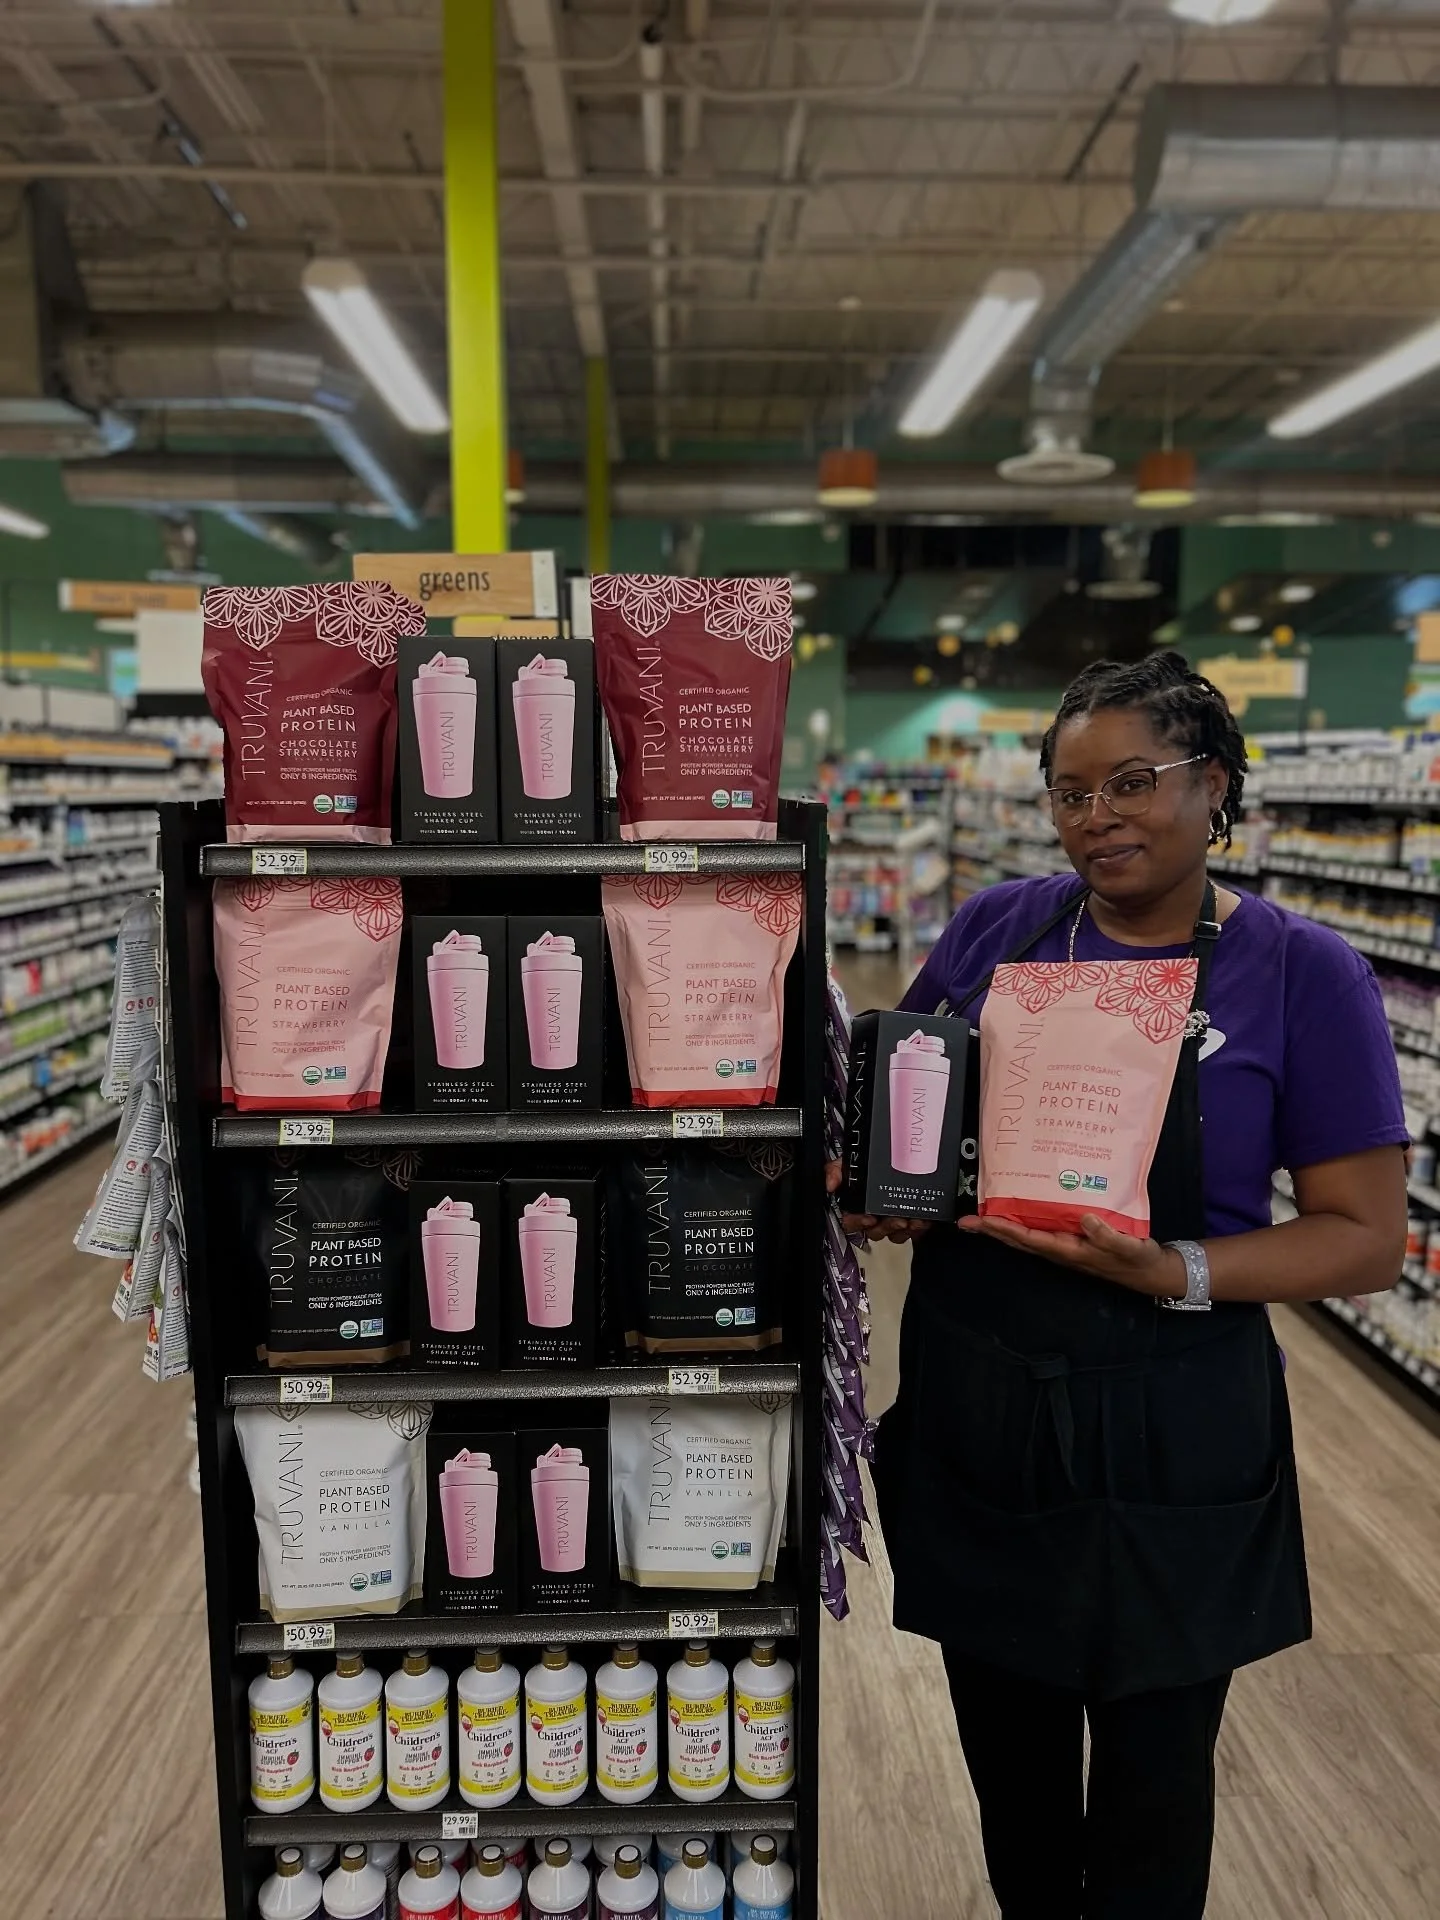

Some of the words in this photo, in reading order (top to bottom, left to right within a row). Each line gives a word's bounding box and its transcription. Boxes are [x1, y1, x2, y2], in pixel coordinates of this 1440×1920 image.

[419, 571, 490, 601] greens
[286, 693, 320, 702] CERTIFIED
[321, 688, 353, 696] ORGANIC
[679, 687, 714, 696] CERTIFIED
[715, 687, 749, 695] ORGANIC
[283, 706, 316, 718] PLANT
[320, 705, 354, 716] BASED
[637, 647, 666, 776] TRUVANI
[679, 703, 713, 714] PLANT
[716, 704, 752, 714] BASED
[241, 660, 274, 781] TRUVANI
[281, 719, 356, 732] PROTEIN
[679, 717, 752, 729] PROTEIN
[280, 740, 357, 749] CHOCOLATE
[440, 711, 456, 780] TRUVANI
[539, 713, 555, 780] TRUVANI
[680, 736, 753, 744] CHOCOLATE
[279, 749, 357, 758] STRAWBERRY
[680, 744, 753, 753] STRAWBERRY
[280, 772, 300, 780] ONLY
[308, 772, 357, 781] INGREDIENTS
[680, 768, 700, 776] ONLY
[701, 768, 706, 776] 8
[708, 768, 753, 776] INGREDIENTS
[255, 854, 297, 867] $52.99
[648, 852, 687, 864] $50.99
[277, 966, 313, 974] CERTIFIED
[314, 967, 350, 975] ORGANIC
[686, 962, 720, 970] CERTIFIED
[236, 921, 266, 1050] TRUVANI
[275, 983, 311, 993] PLANT
[314, 986, 349, 996] BASED
[647, 919, 671, 1047] TRUVANI
[686, 979, 719, 989] PLANT
[723, 978, 757, 989] BASED
[274, 999, 348, 1011] PROTEIN
[685, 992, 755, 1005] PROTEIN
[272, 1019, 345, 1029] STRAWBERRY
[452, 986, 468, 1051] TRUVANI
[547, 988, 561, 1052] TRUVANI
[684, 1014, 753, 1022] STRAWBERRY
[300, 1045, 346, 1053] INGREDIENTS
[686, 1039, 704, 1047] ONLY
[712, 1038, 755, 1046] INGREDIENTS
[1083, 1064, 1122, 1077] ORGANIC
[994, 1023, 1044, 1151] TRUVANI
[1043, 1081, 1078, 1091] PLANT
[1081, 1083, 1121, 1097] BASED
[1039, 1096, 1118, 1116] PROTEIN
[675, 1117, 714, 1129] $52.99
[848, 1051, 866, 1187] TRUVANI
[910, 1087, 927, 1154] TRUVANI
[283, 1124, 323, 1136] $52.99
[1034, 1118, 1116, 1134] STRAWBERRY
[1031, 1145, 1050, 1153] ONLY
[1058, 1147, 1111, 1160] INGREDIENTS
[879, 1185, 920, 1193] STAINLESS
[312, 1222, 347, 1230] CERTIFIED
[347, 1220, 381, 1229] ORGANIC
[645, 1167, 670, 1295] TRUVANI
[685, 1229, 717, 1239] PLANT
[721, 1228, 754, 1238] BASED
[270, 1177, 298, 1308] TRUVANI
[310, 1240, 345, 1251] PLANT
[348, 1238, 381, 1249] BASED
[685, 1242, 754, 1255] PROTEIN
[309, 1252, 382, 1267] PROTEIN
[308, 1273, 382, 1284] CHOCOLATE
[446, 1252, 460, 1313] TRUVANI
[543, 1248, 557, 1310] TRUVANI
[711, 1287, 755, 1296] INGREDIENTS
[308, 1302, 327, 1310] ONLY
[336, 1299, 383, 1308] INGREDIENTS
[672, 1373, 709, 1385] $52.99
[283, 1381, 322, 1394] $50.99
[648, 1398, 673, 1526] TRUVANI
[686, 1454, 718, 1463] PLANT
[720, 1454, 753, 1464] BASED
[320, 1469, 354, 1478] CERTIFIED
[355, 1467, 388, 1476] ORGANIC
[685, 1468, 753, 1480] PROTEIN
[319, 1487, 353, 1498] PLANT
[356, 1484, 390, 1496] BASED
[279, 1433, 304, 1564] TRUVANI
[319, 1498, 390, 1515] PROTEIN
[320, 1519, 391, 1533] VANILLA
[463, 1501, 478, 1561] TRUVANI
[556, 1496, 569, 1556] TRUVANI
[319, 1556, 338, 1564] ONLY
[345, 1549, 391, 1562] INGREDIENTS
[671, 1615, 709, 1627] $50.99
[286, 1626, 325, 1642] $50.99
[467, 1728, 513, 1742] Children's
[537, 1726, 582, 1740] Children's
[602, 1725, 646, 1737] Children's
[675, 1726, 720, 1737] Children's
[744, 1723, 789, 1735] Children's
[253, 1735, 297, 1749] Children's
[327, 1733, 373, 1747] Children's
[394, 1731, 441, 1746] Children's
[444, 1816, 470, 1825] $29.99
